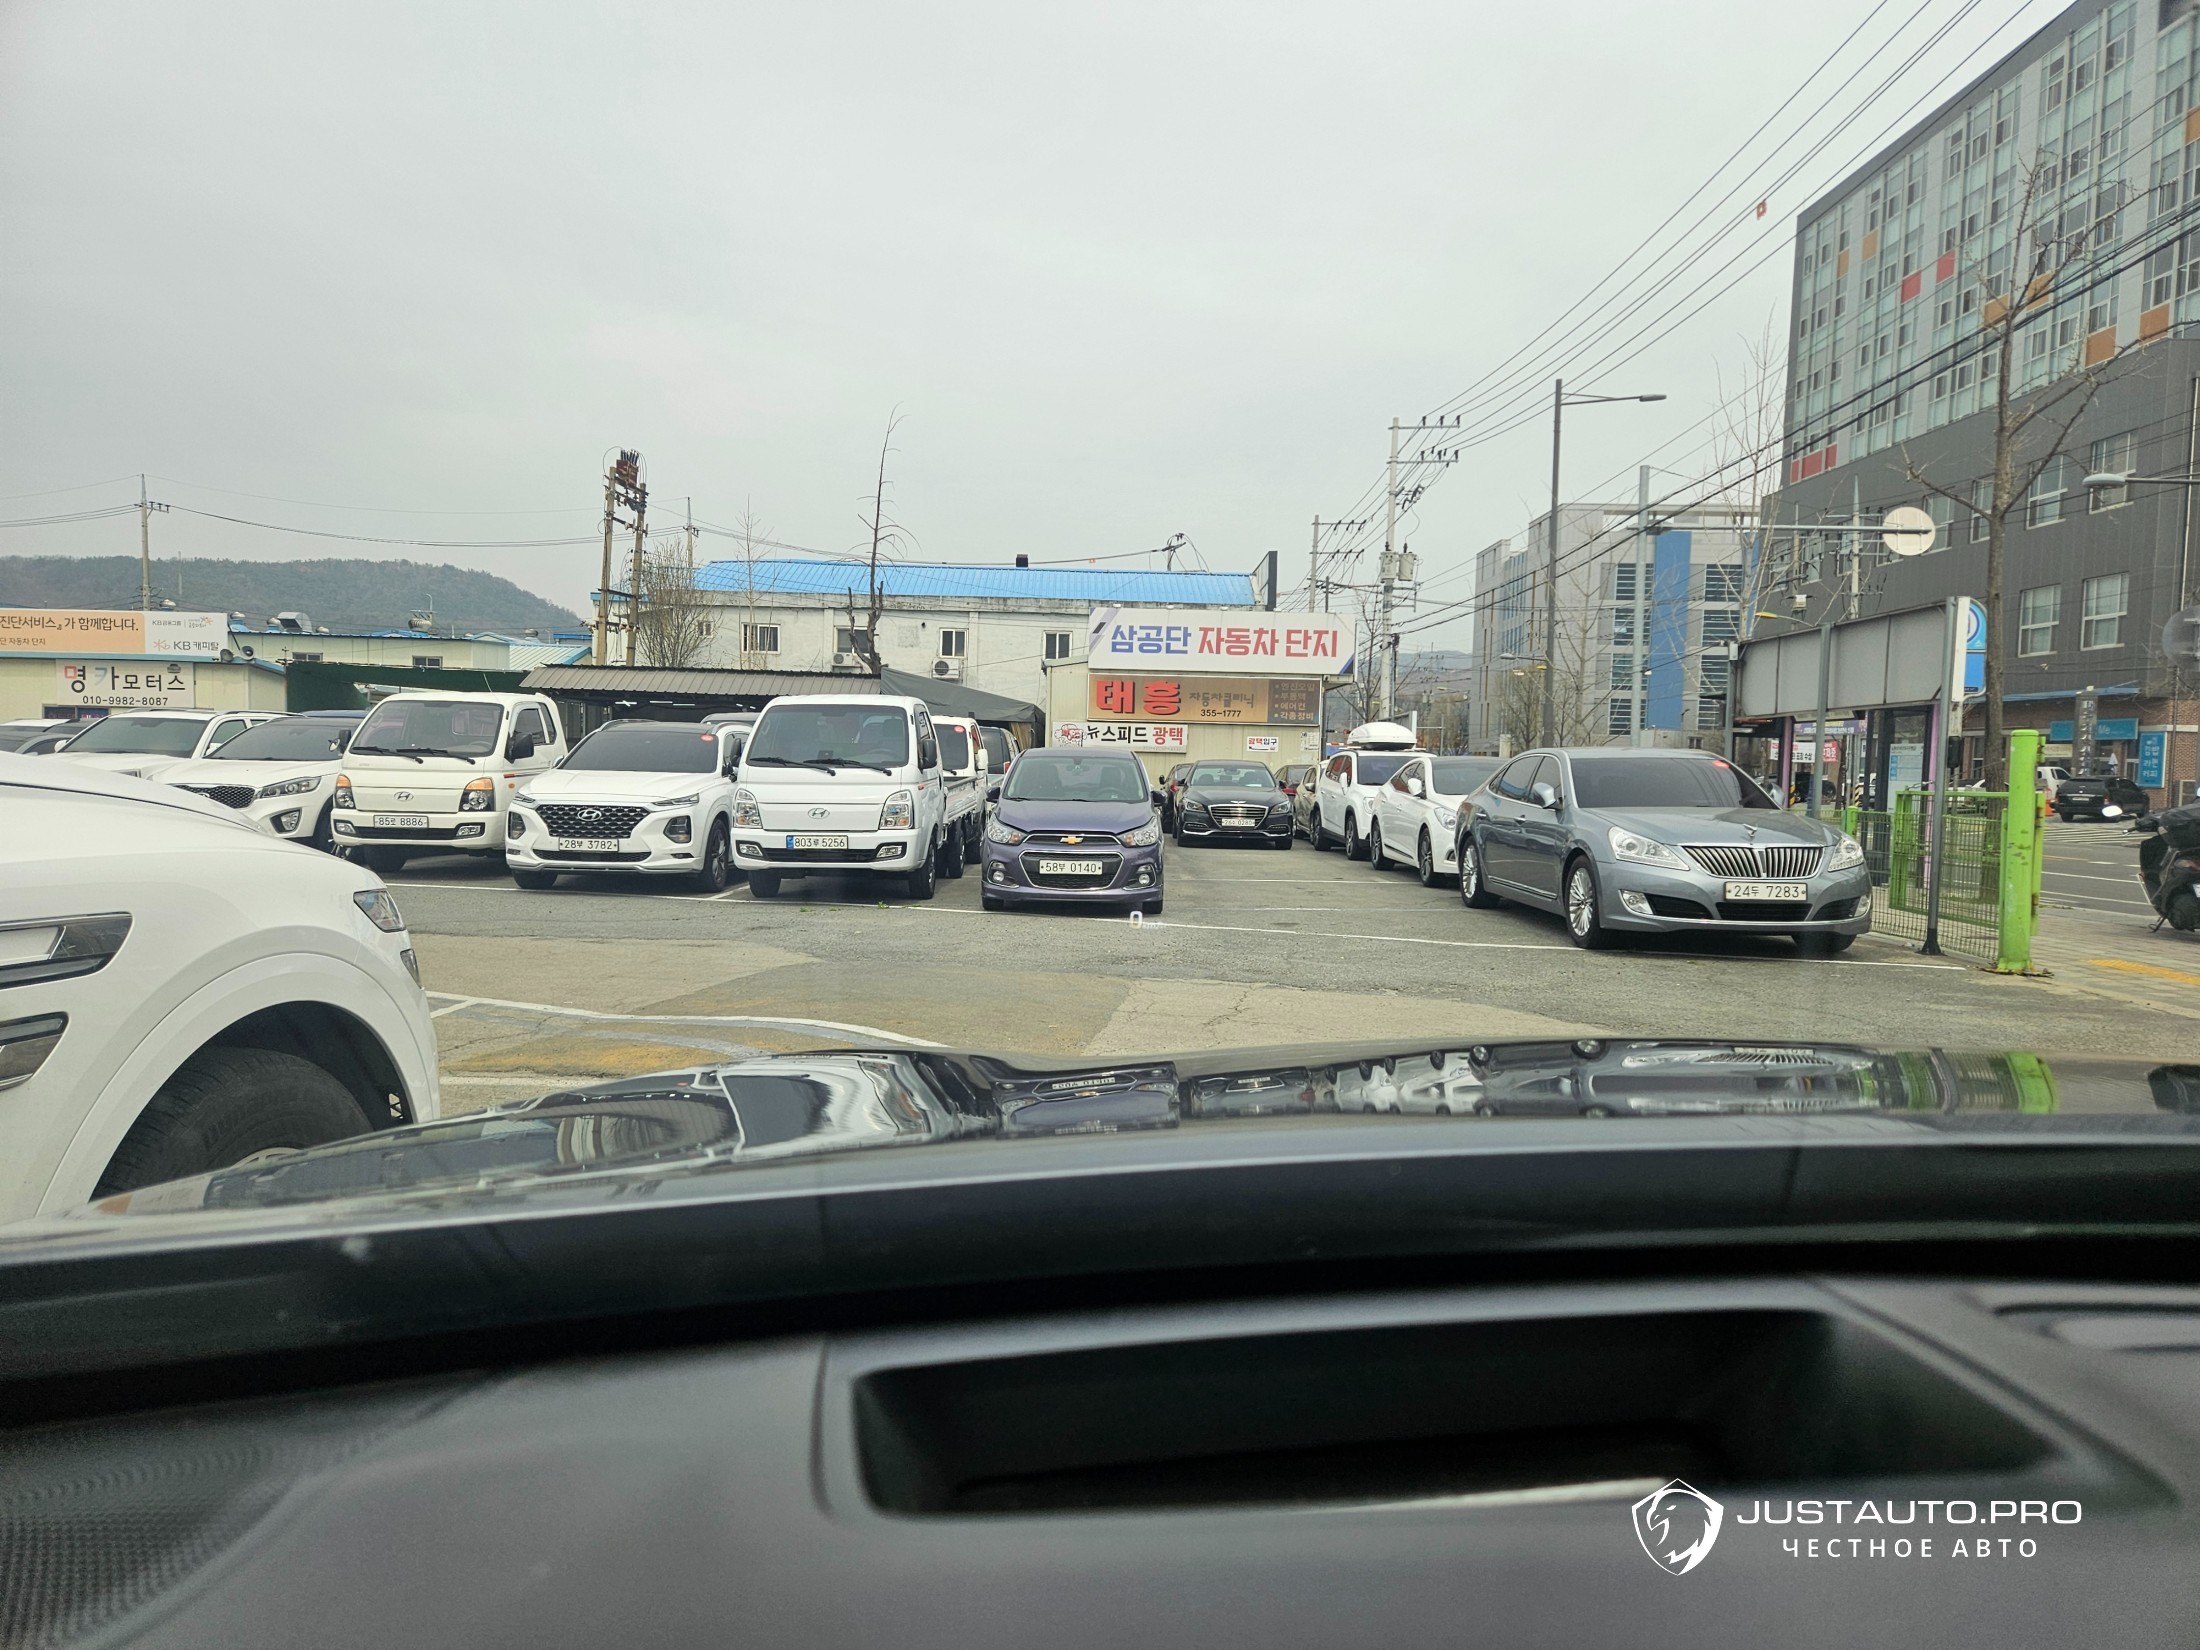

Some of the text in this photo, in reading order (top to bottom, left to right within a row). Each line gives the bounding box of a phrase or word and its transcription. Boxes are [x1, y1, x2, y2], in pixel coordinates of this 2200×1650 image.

[9, 637, 30, 646] 자동차
[31, 637, 46, 646] 단지
[1111, 624, 1338, 658] 삼공단 자동차 단지
[82, 695, 169, 706] 010-9982-8087
[1096, 680, 1182, 716] 태흥
[1280, 702, 1306, 711] 에어컨
[1200, 709, 1242, 718] 355-1777
[1087, 725, 1184, 746] 뉴스피드 광택
[400, 817, 424, 826] 8886
[587, 840, 613, 850] 3782
[821, 837, 845, 848] 5256
[1070, 862, 1097, 873] 0140
[1733, 885, 1800, 898] 24두 7283
